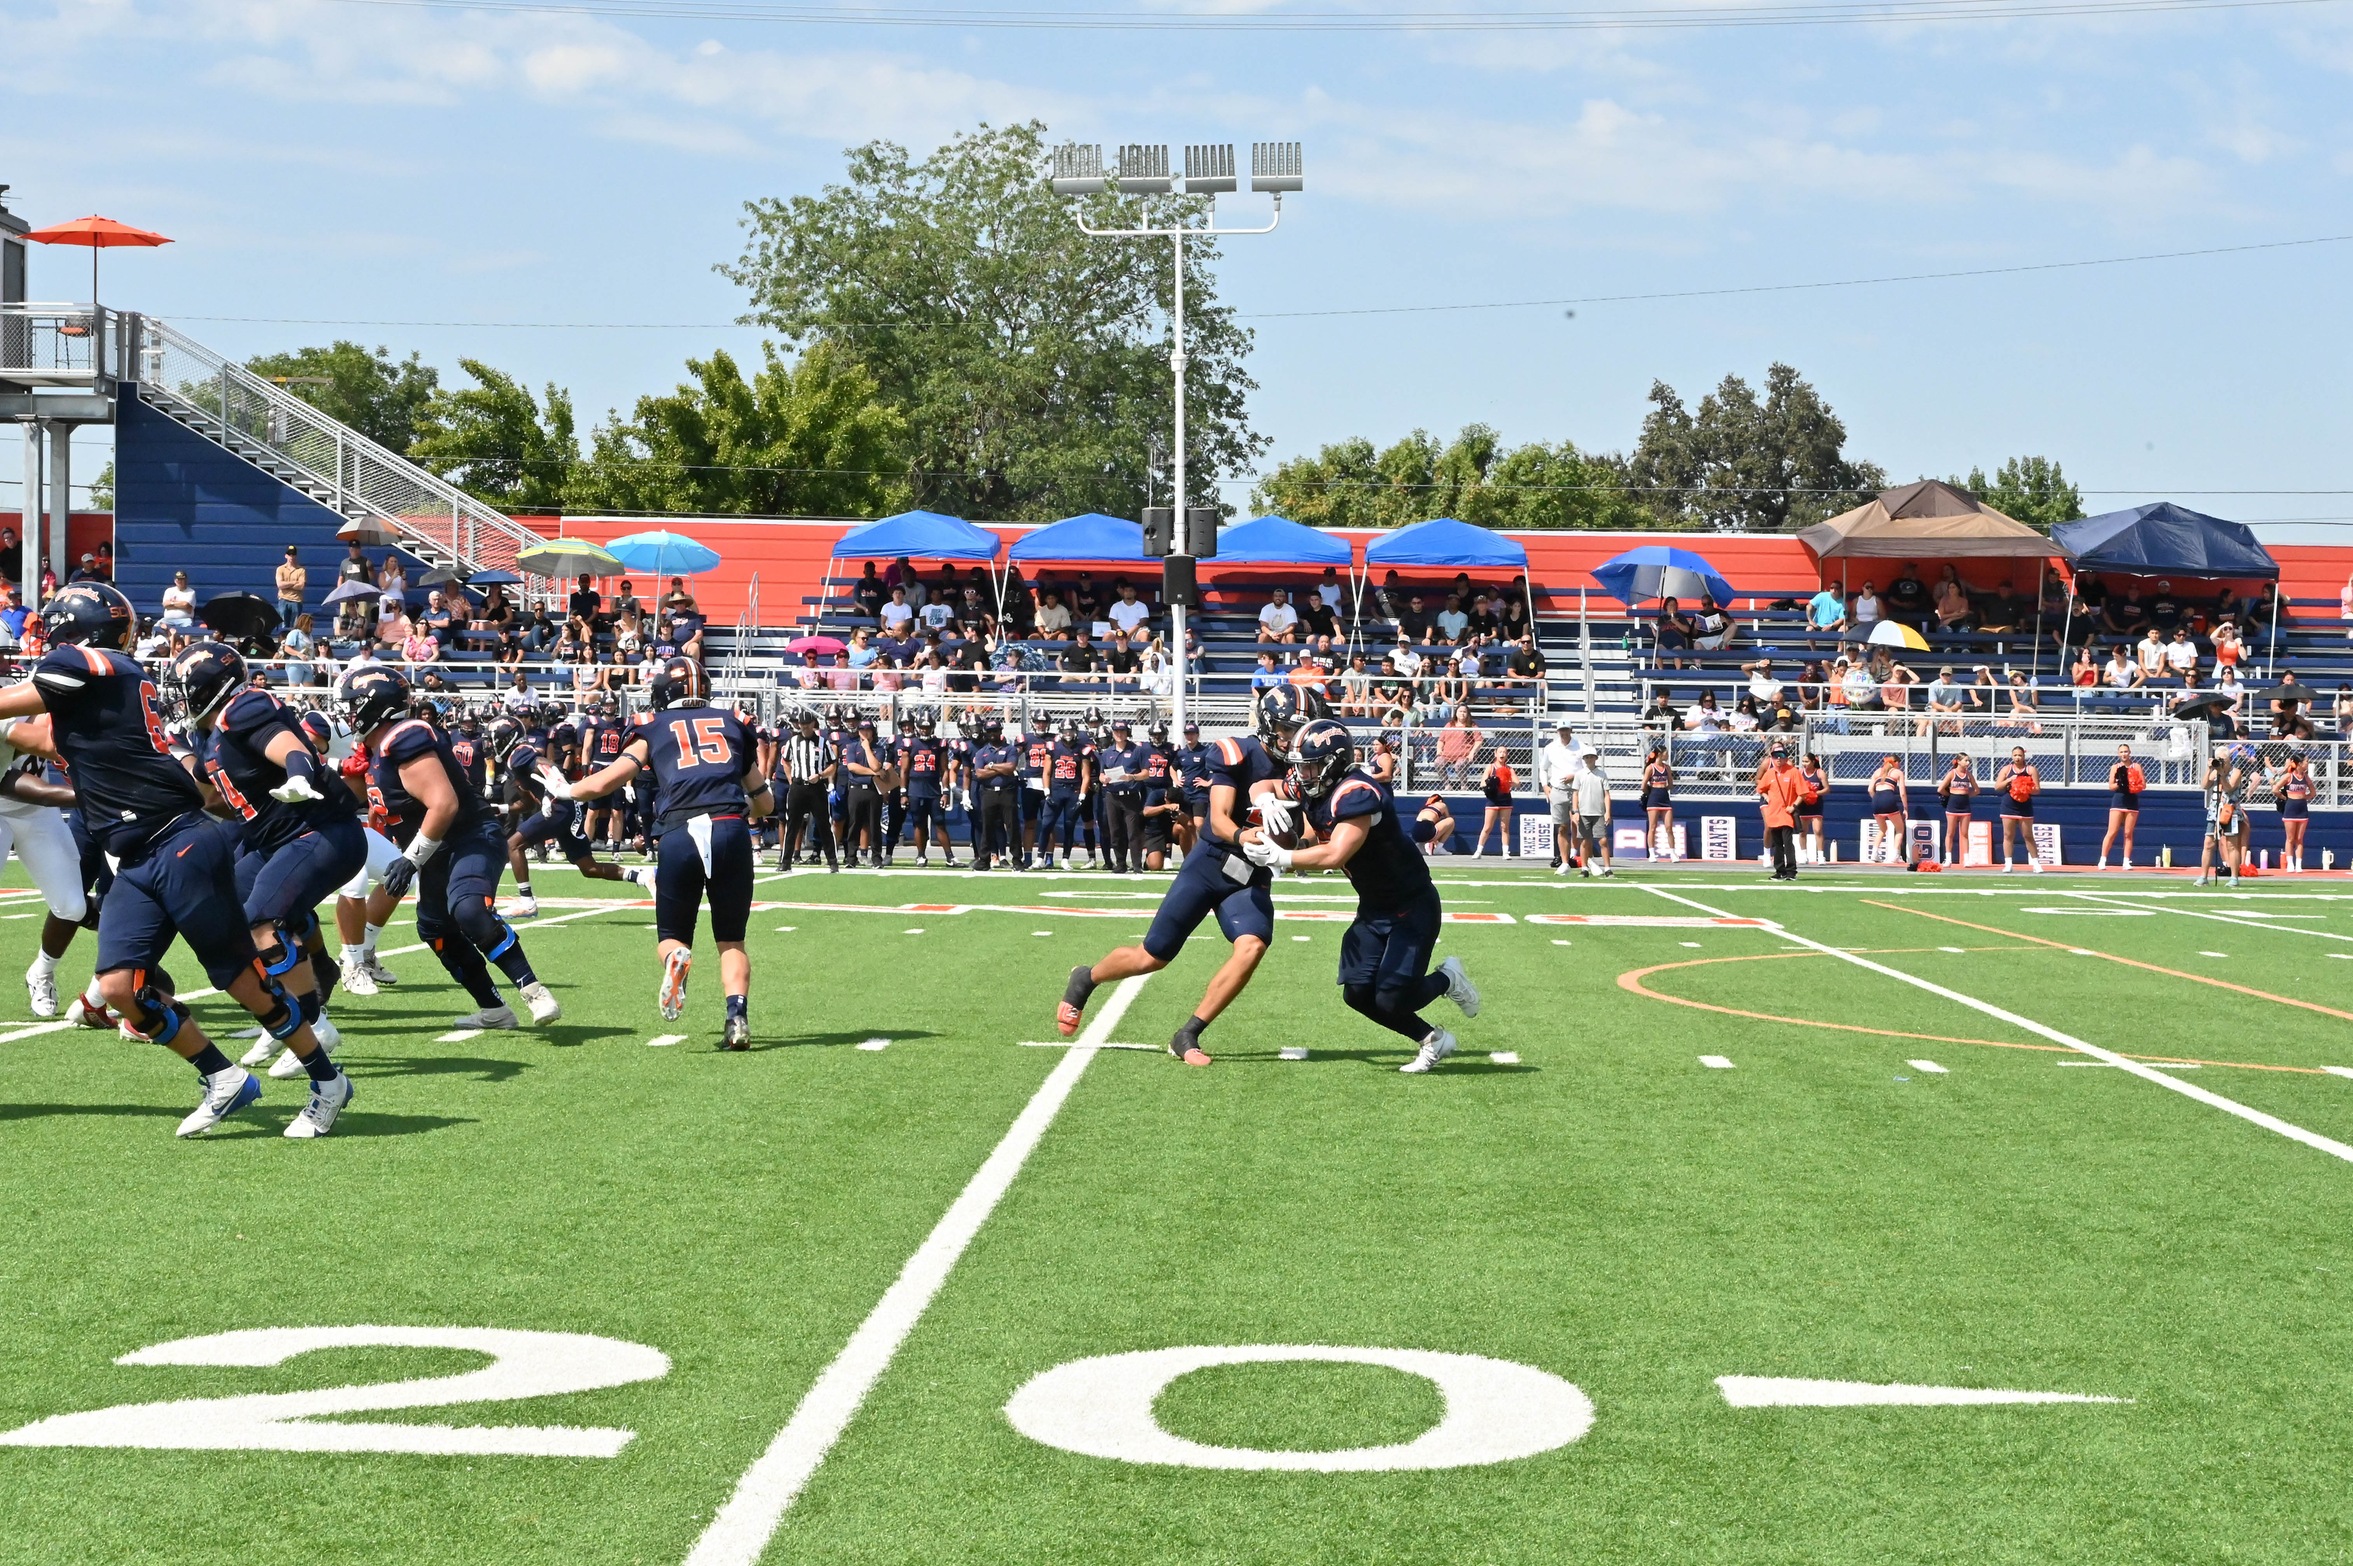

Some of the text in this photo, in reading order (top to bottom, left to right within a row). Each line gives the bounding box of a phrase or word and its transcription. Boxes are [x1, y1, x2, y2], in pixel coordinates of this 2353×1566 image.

[600, 734, 620, 754] 18
[669, 717, 732, 770] 15
[914, 755, 936, 772] 24
[1524, 817, 1536, 855] MAKE SOME
[1538, 823, 1551, 850] NOISE
[1708, 818, 1728, 859] GIANTS
[1911, 823, 1935, 861] GO
